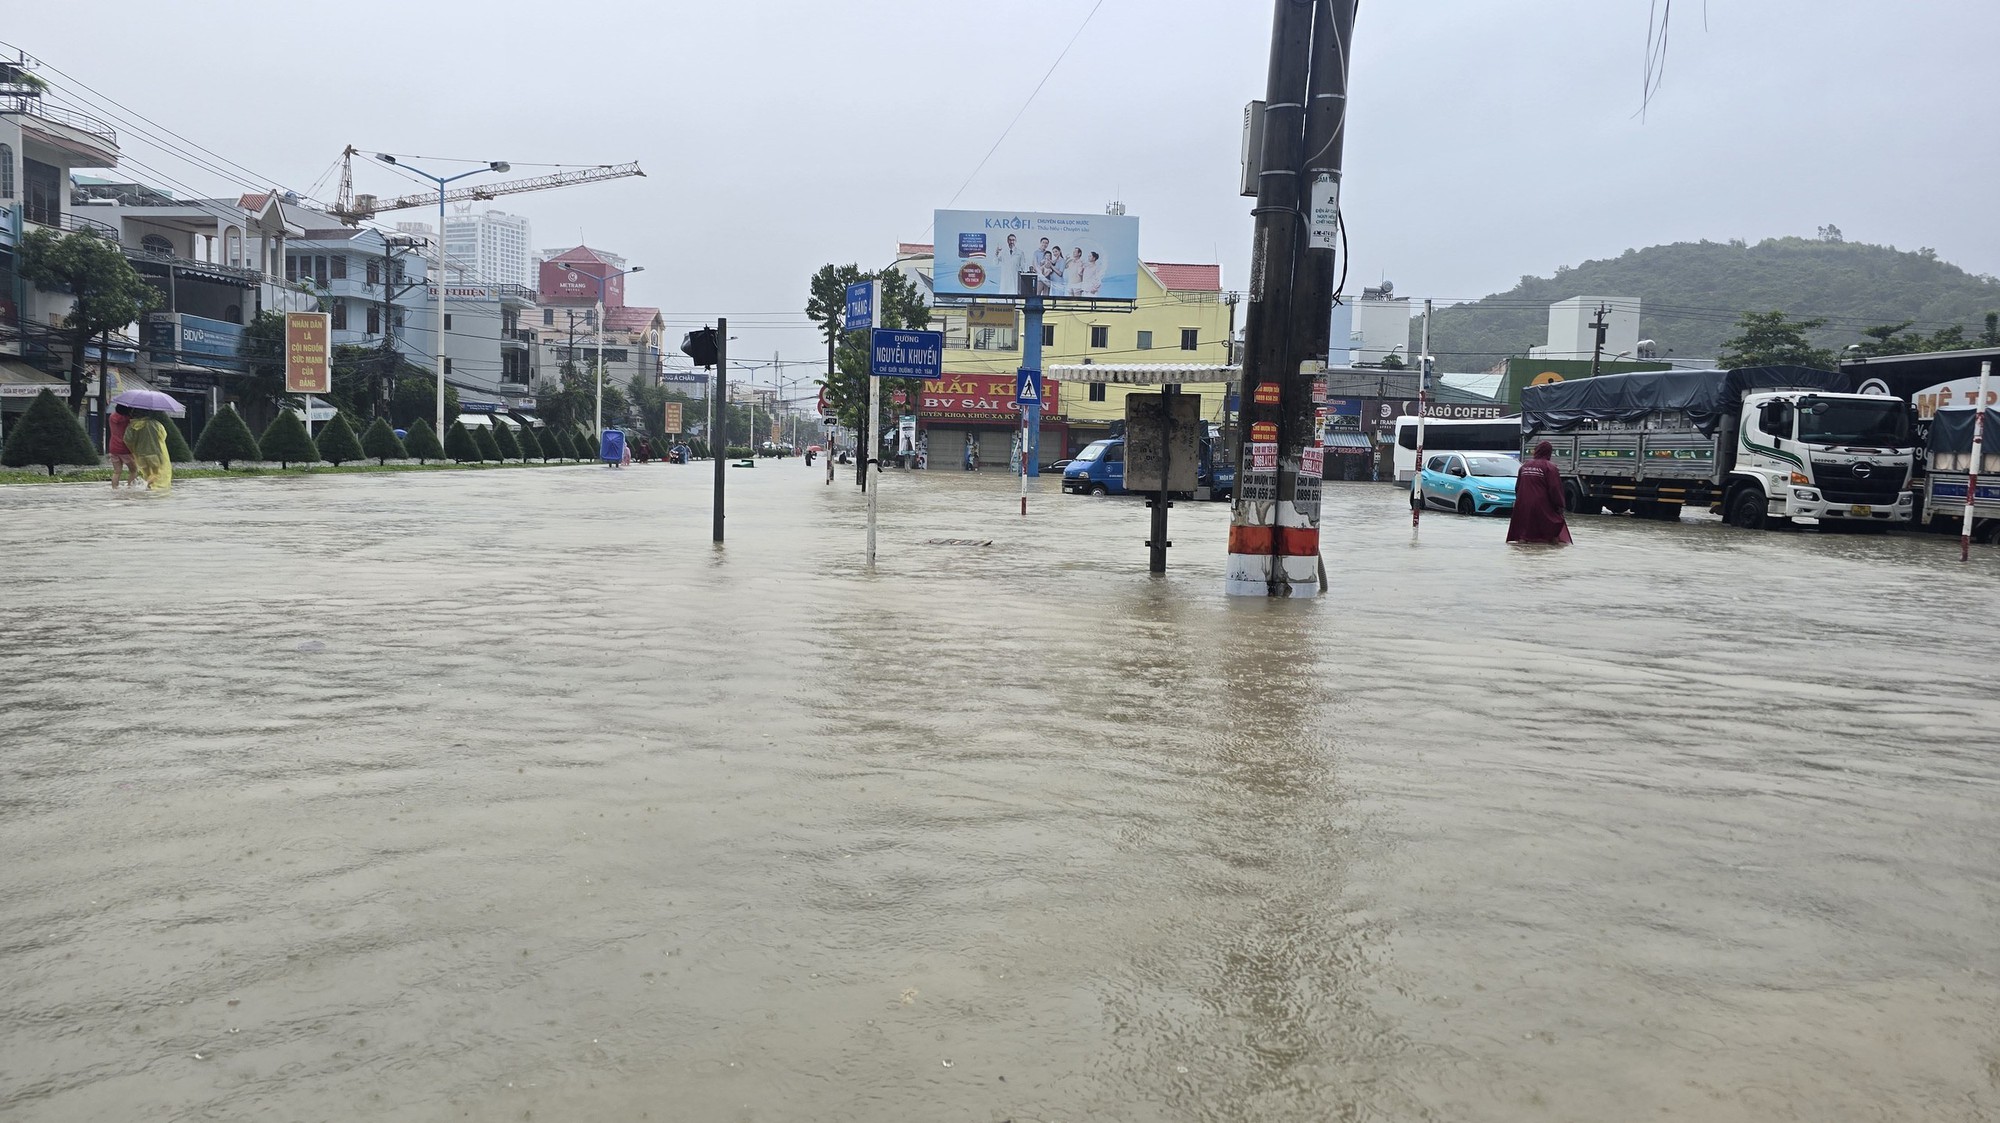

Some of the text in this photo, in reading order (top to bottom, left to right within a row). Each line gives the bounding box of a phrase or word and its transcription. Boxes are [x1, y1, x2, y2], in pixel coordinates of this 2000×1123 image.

[985, 216, 1031, 230] KAROFI
[852, 297, 867, 317] THÁNG
[292, 320, 322, 328] NHÂN DÂN
[184, 328, 201, 341] BIDV
[304, 332, 311, 340] LÀ
[894, 334, 919, 343] ĐƯỜNG
[292, 343, 323, 353] CỘI NGUỒN
[876, 342, 937, 365] NGUYỄN KHUYẾN
[292, 355, 305, 363] SỨC
[302, 366, 314, 375] CỦA
[300, 377, 316, 387] ĐẢNG
[924, 375, 1052, 397] MẮT KÍH
[924, 397, 1050, 411] BV SÀI GN
[1918, 386, 1952, 418] MÊ
[967, 411, 990, 419] KHÚC
[1454, 406, 1501, 419] COFFEE
[1243, 475, 1253, 484] CHO
[1254, 474, 1268, 486] MƯỢN
[1297, 477, 1307, 486] CHO
[1243, 487, 1257, 498] 0899
[1297, 489, 1311, 501] 0899
